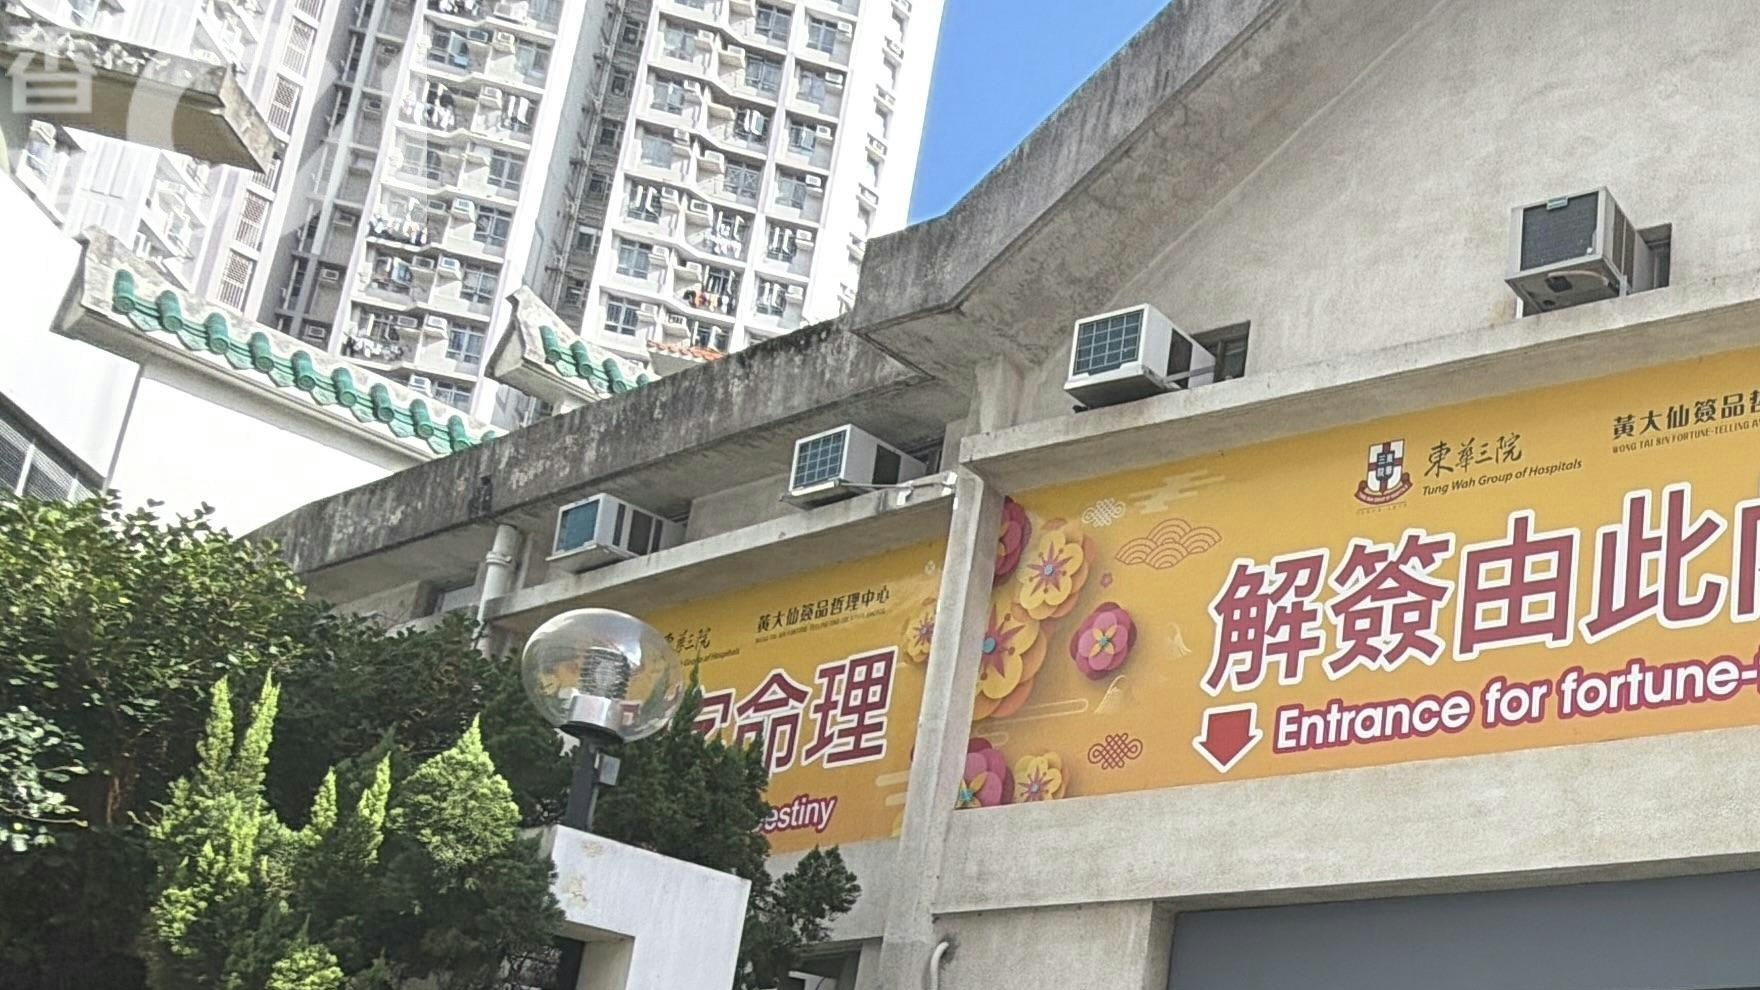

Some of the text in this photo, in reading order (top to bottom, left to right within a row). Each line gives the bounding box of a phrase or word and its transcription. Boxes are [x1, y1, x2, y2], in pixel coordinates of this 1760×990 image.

[1671, 419, 1750, 443] FORTUNE-TELLING
[1423, 432, 1523, 478] 東華三院
[1422, 485, 1449, 497] Tung
[1451, 477, 1476, 491] Wah
[1479, 472, 1513, 486] Group
[1514, 466, 1528, 479] of
[1528, 458, 1583, 476] Hospitals
[1275, 694, 1472, 751] Entrance
[1485, 681, 1549, 724] for
[758, 796, 838, 831] estiny
